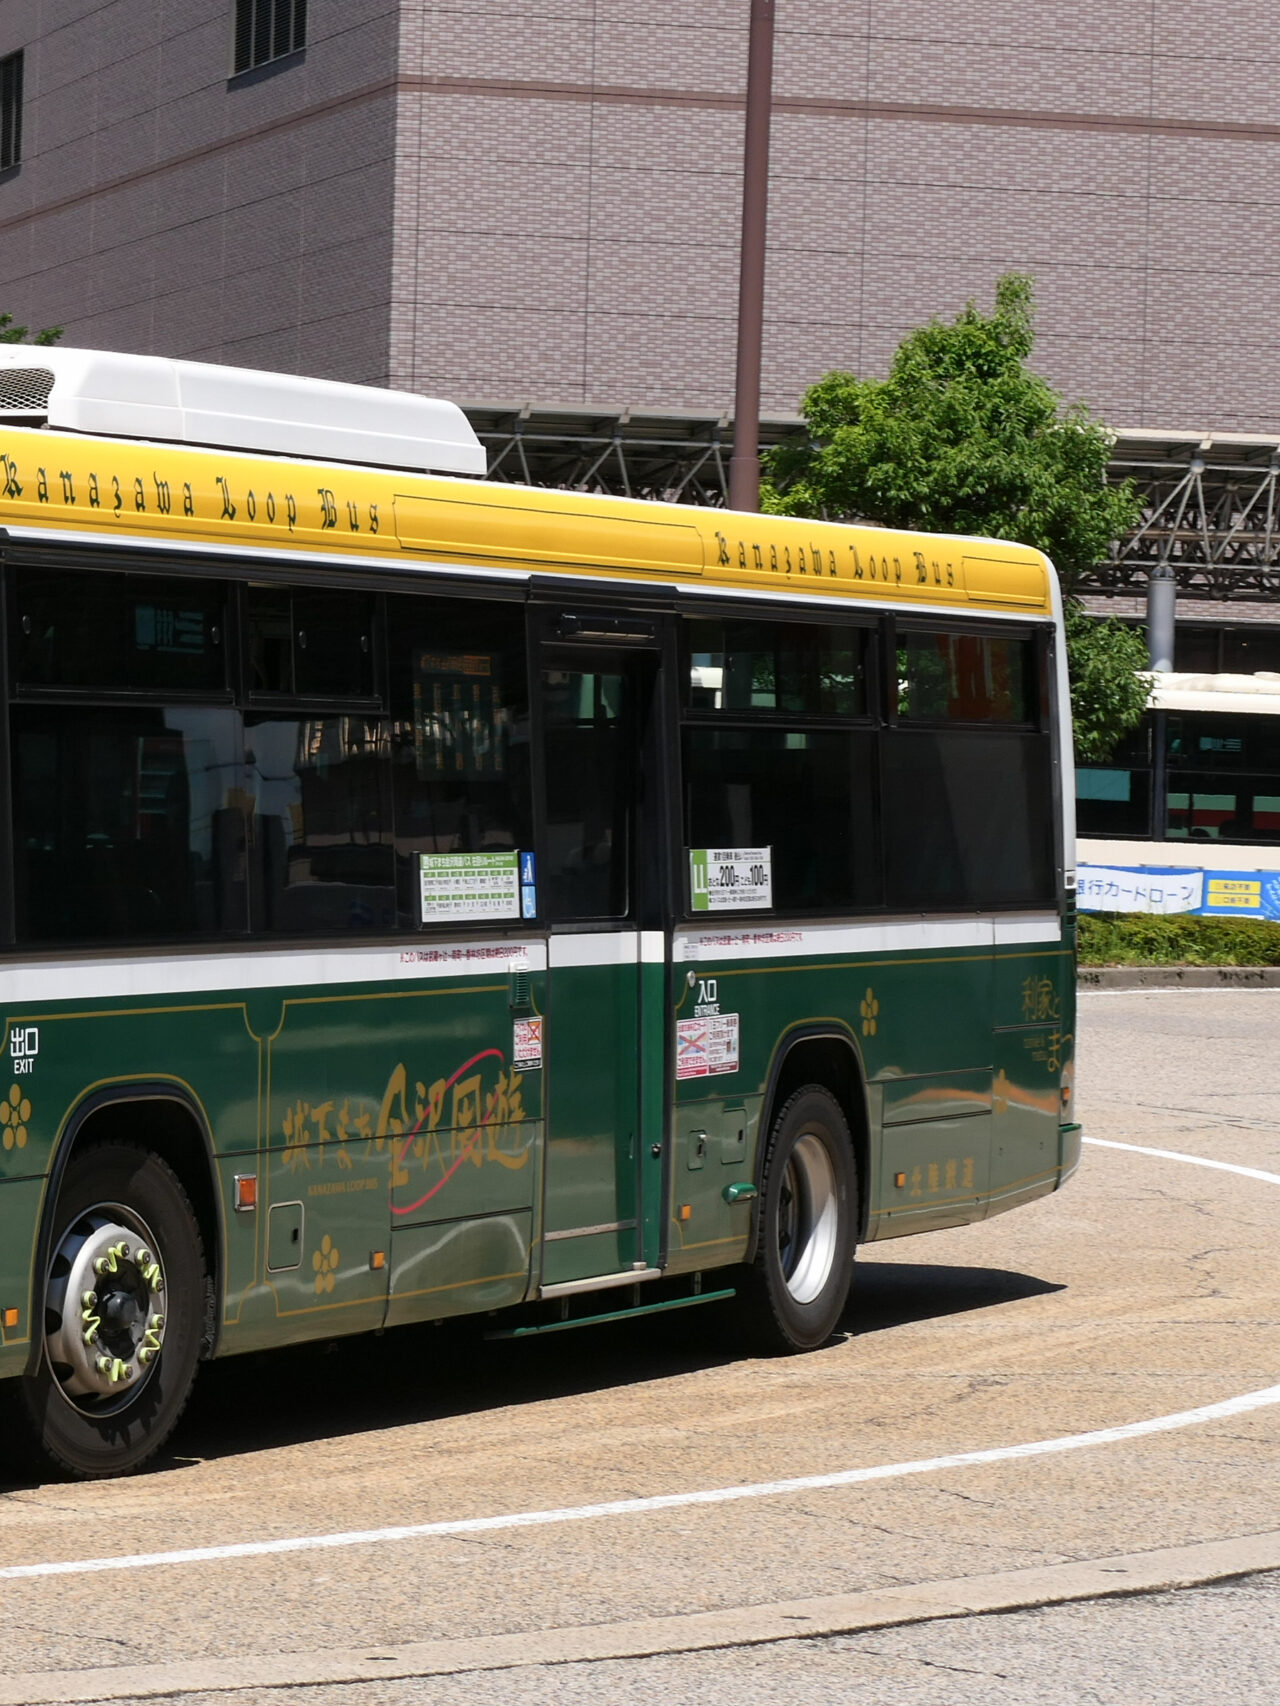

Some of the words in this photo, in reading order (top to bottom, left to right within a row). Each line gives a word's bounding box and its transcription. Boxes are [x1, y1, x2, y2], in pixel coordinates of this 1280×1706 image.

[0, 453, 195, 518] Kanazawa
[216, 476, 297, 533] Loop
[317, 488, 380, 534] Bus
[714, 531, 837, 579] Kanazawa
[849, 545, 902, 588] Loop
[913, 551, 954, 587] Bus
[697, 979, 717, 1004] 入口
[694, 1003, 720, 1018] ENTRANCE
[10, 1027, 39, 1057] 出口
[14, 1058, 35, 1074] EXIT
